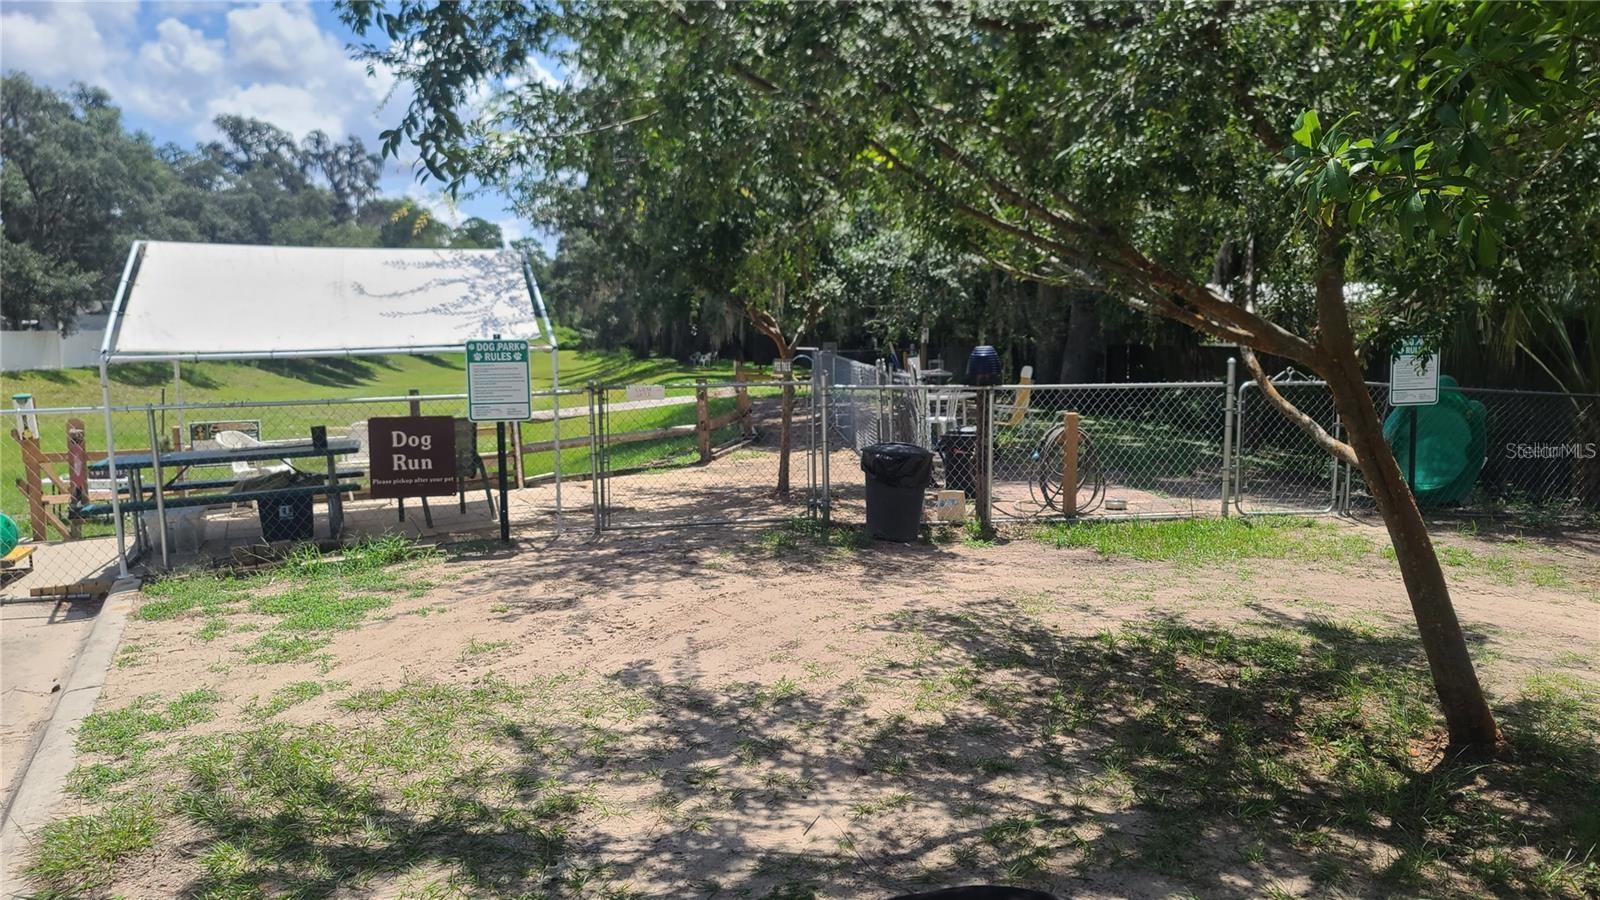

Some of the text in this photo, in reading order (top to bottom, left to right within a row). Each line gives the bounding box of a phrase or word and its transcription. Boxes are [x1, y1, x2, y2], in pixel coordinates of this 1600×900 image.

[476, 342, 520, 351] DOG PARK
[484, 352, 512, 361] RULES
[391, 430, 432, 450] Dog
[392, 454, 433, 471] Run
[393, 477, 413, 485] pickup
